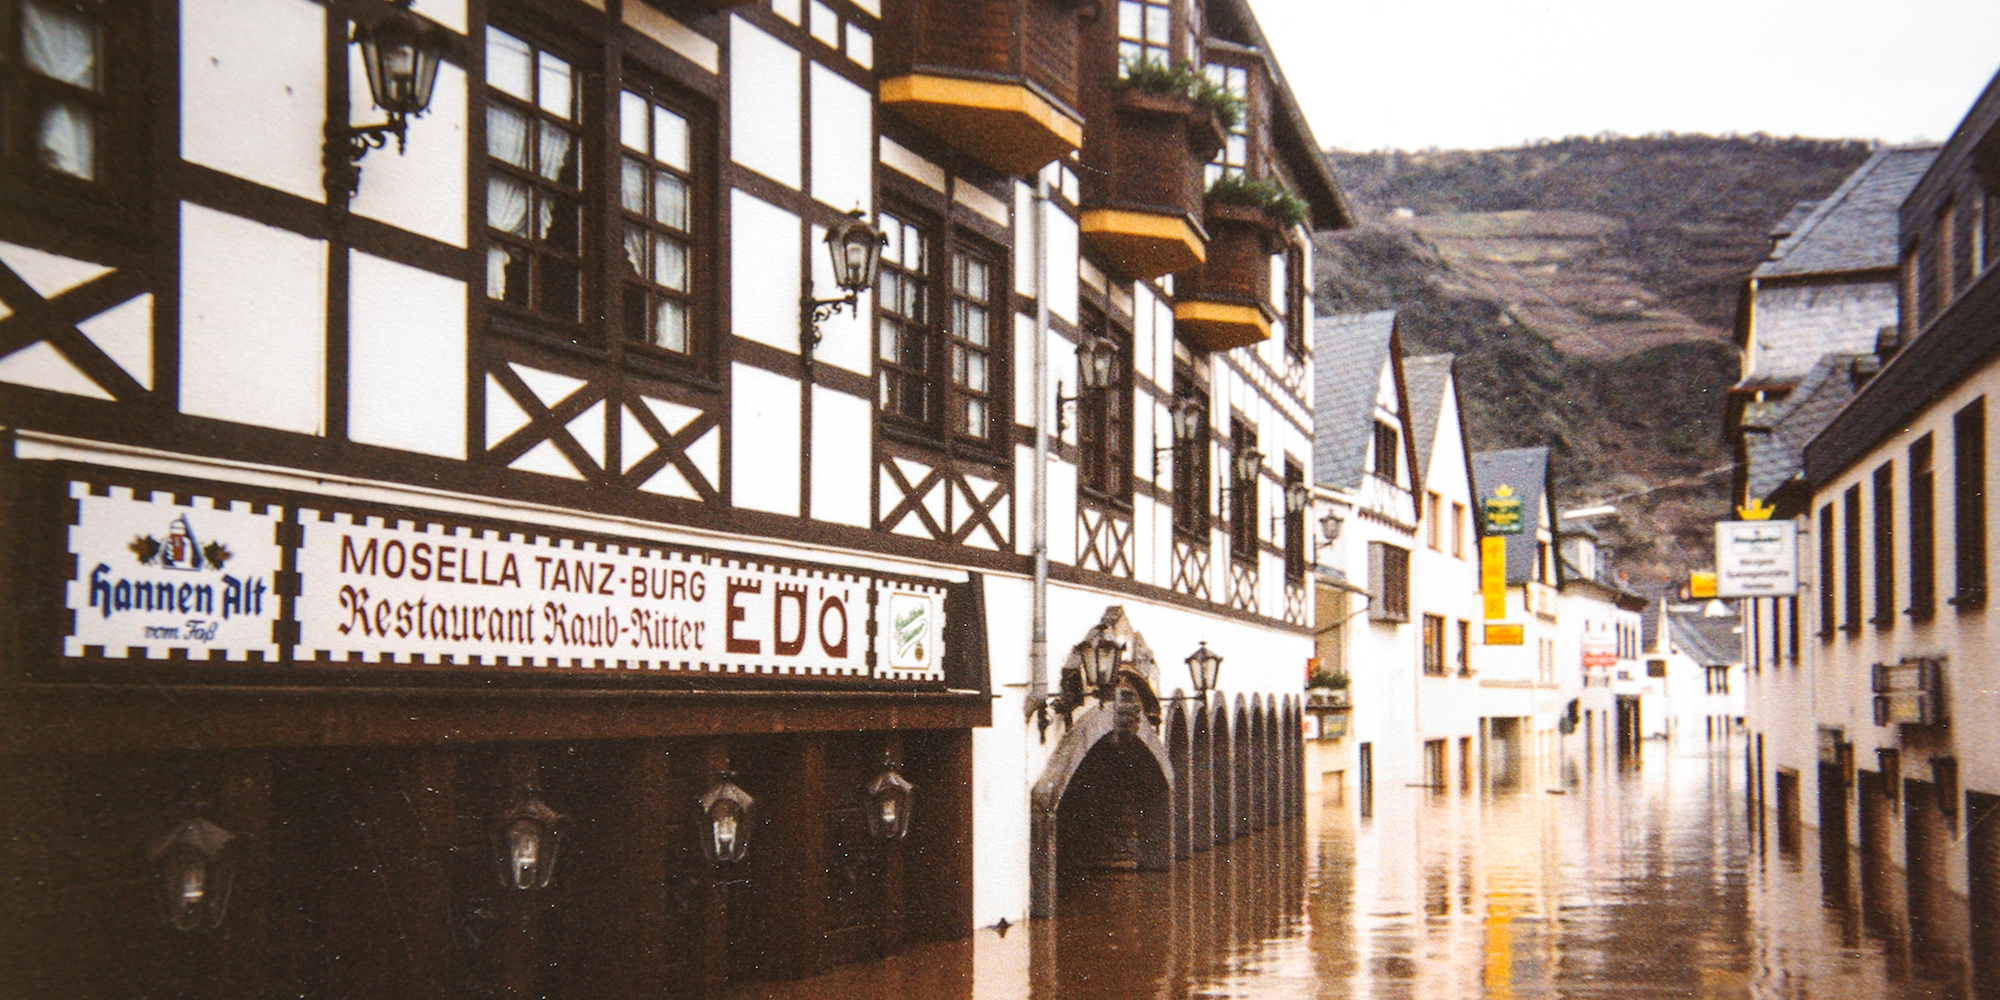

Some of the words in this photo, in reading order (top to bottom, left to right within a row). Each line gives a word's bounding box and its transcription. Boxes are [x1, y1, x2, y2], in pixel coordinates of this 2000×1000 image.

[89, 562, 213, 619] Hannen
[222, 574, 267, 620] Alt
[340, 534, 521, 588] MOSELLA
[535, 556, 706, 602] TANZ-BURG
[144, 624, 180, 640] vom
[337, 584, 535, 645] Restaurant
[543, 601, 706, 650] Raub-Ritter
